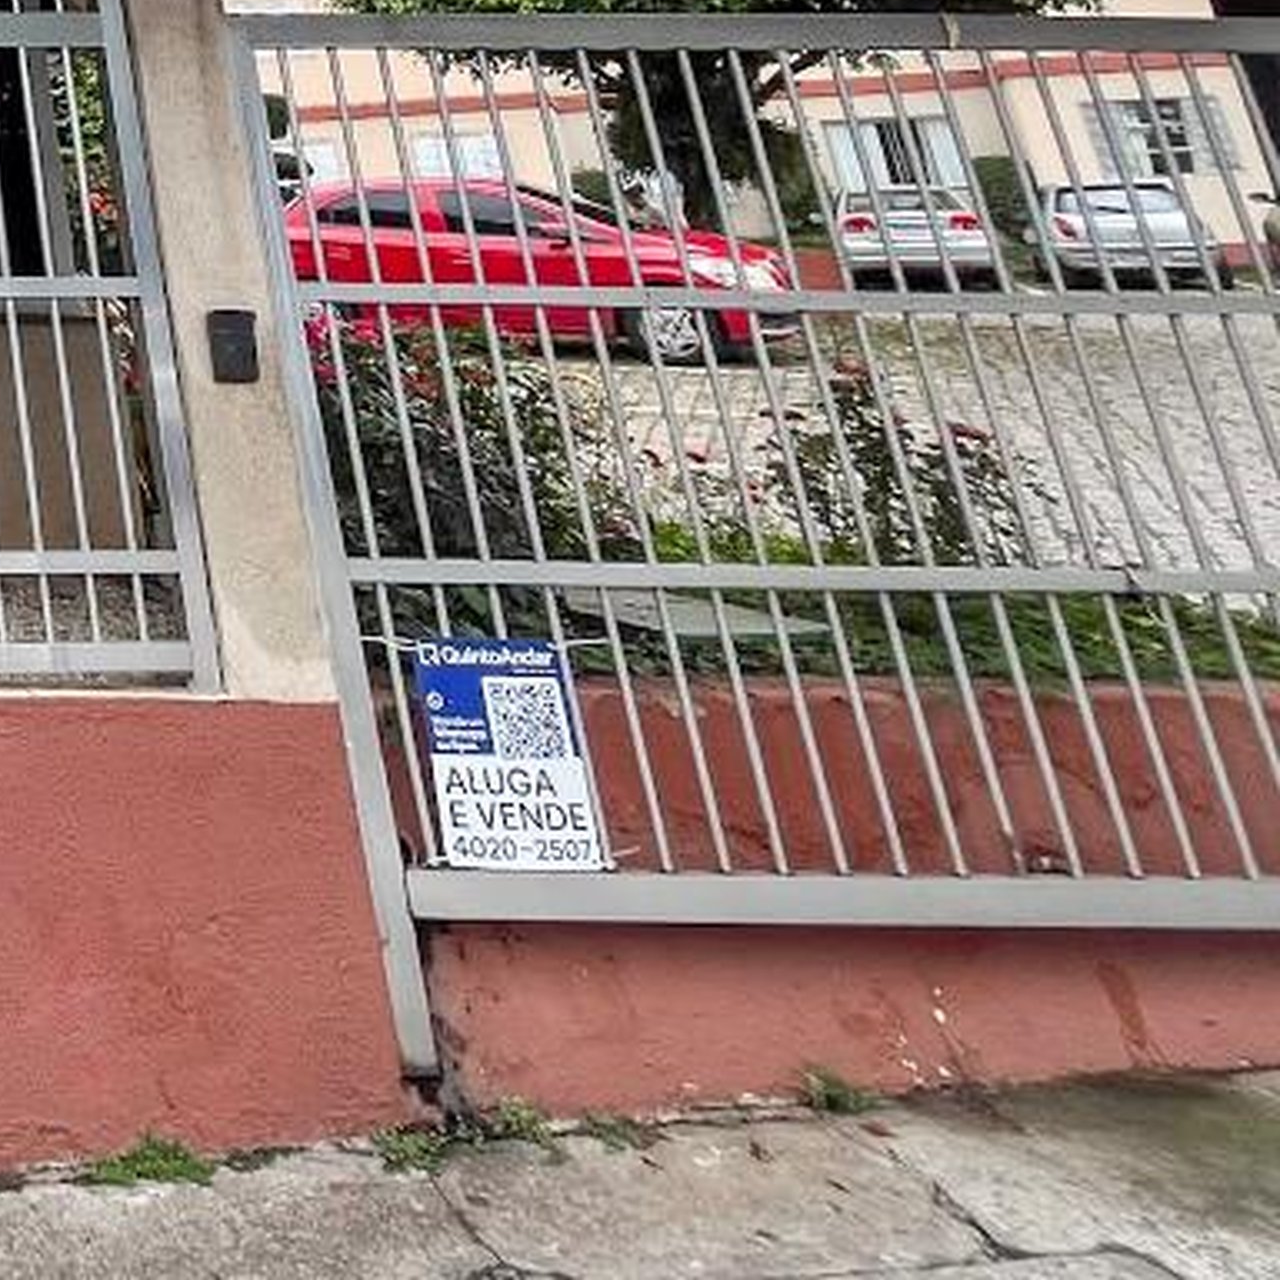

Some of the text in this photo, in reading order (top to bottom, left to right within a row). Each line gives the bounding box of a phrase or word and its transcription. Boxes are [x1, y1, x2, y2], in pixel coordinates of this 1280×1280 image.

[446, 767, 558, 797] ALUGA
[449, 800, 589, 832] E VENDE
[452, 835, 591, 862] 4020-2507
